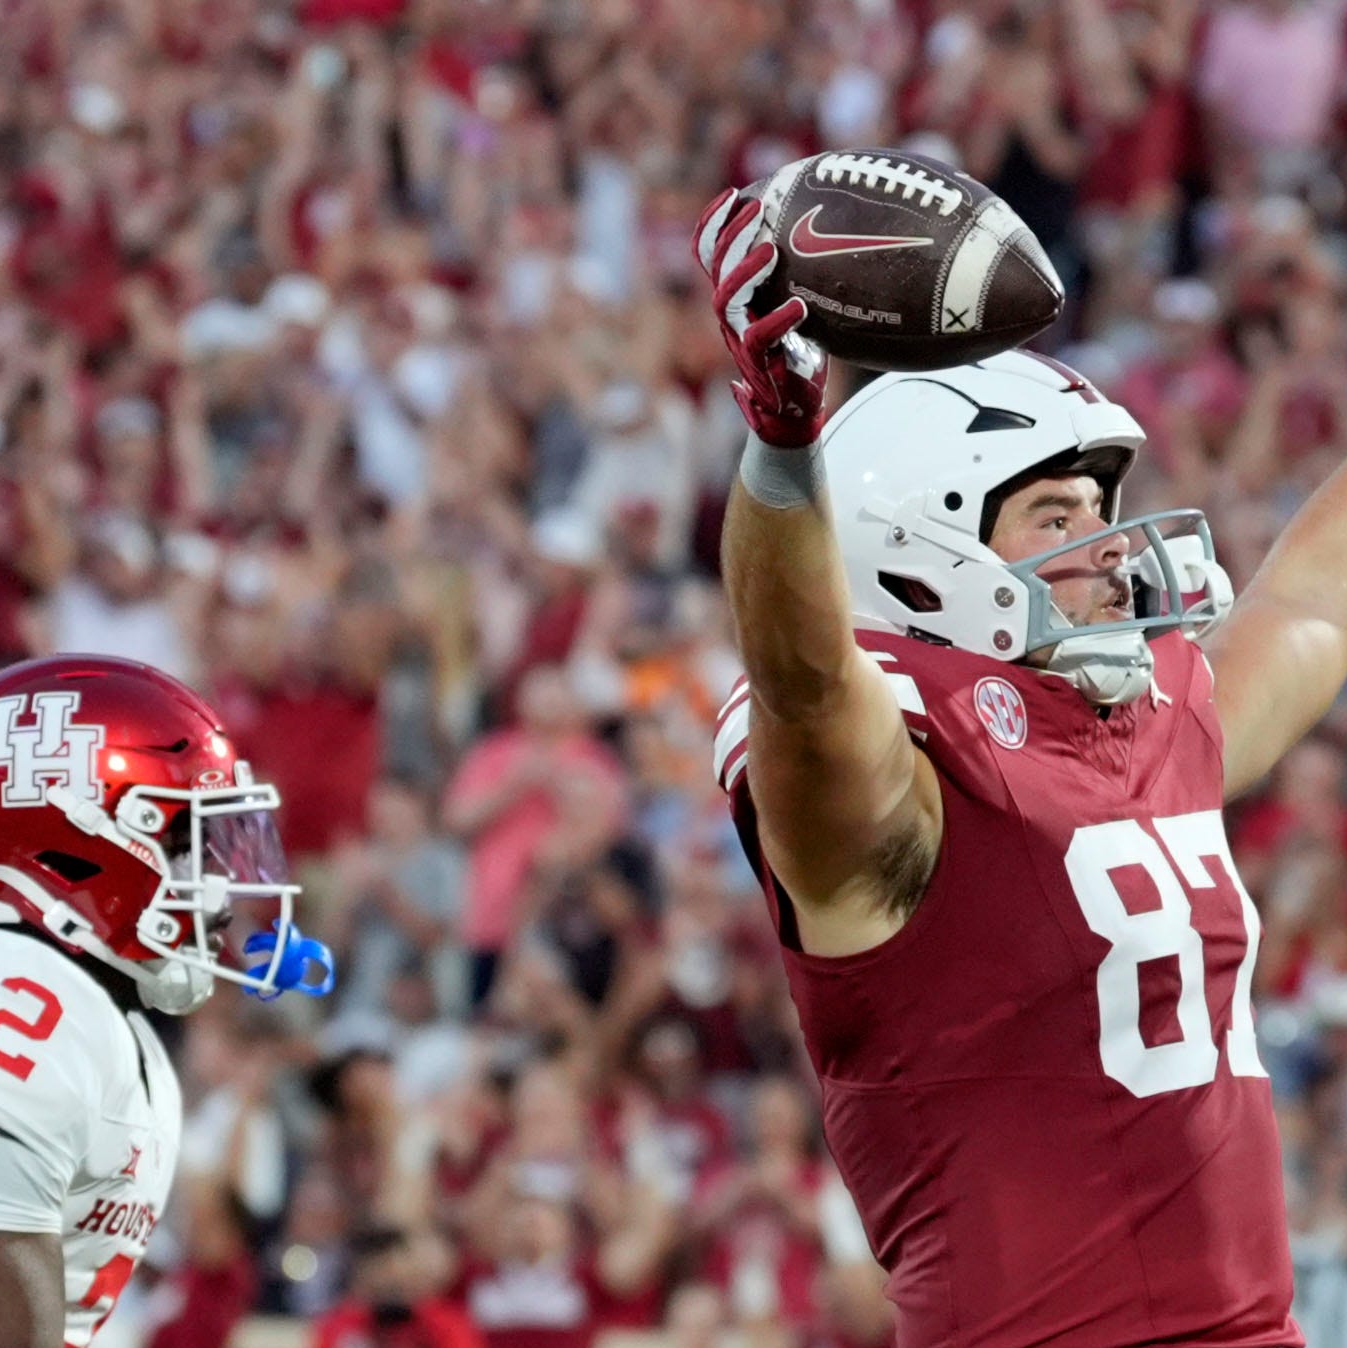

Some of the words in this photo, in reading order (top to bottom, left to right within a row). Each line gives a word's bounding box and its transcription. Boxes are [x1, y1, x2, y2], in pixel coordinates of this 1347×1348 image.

[789, 280, 844, 314] VAPOR
[843, 304, 902, 325] ELITE
[977, 681, 1026, 744] SEC
[1064, 809, 1271, 1099] 87
